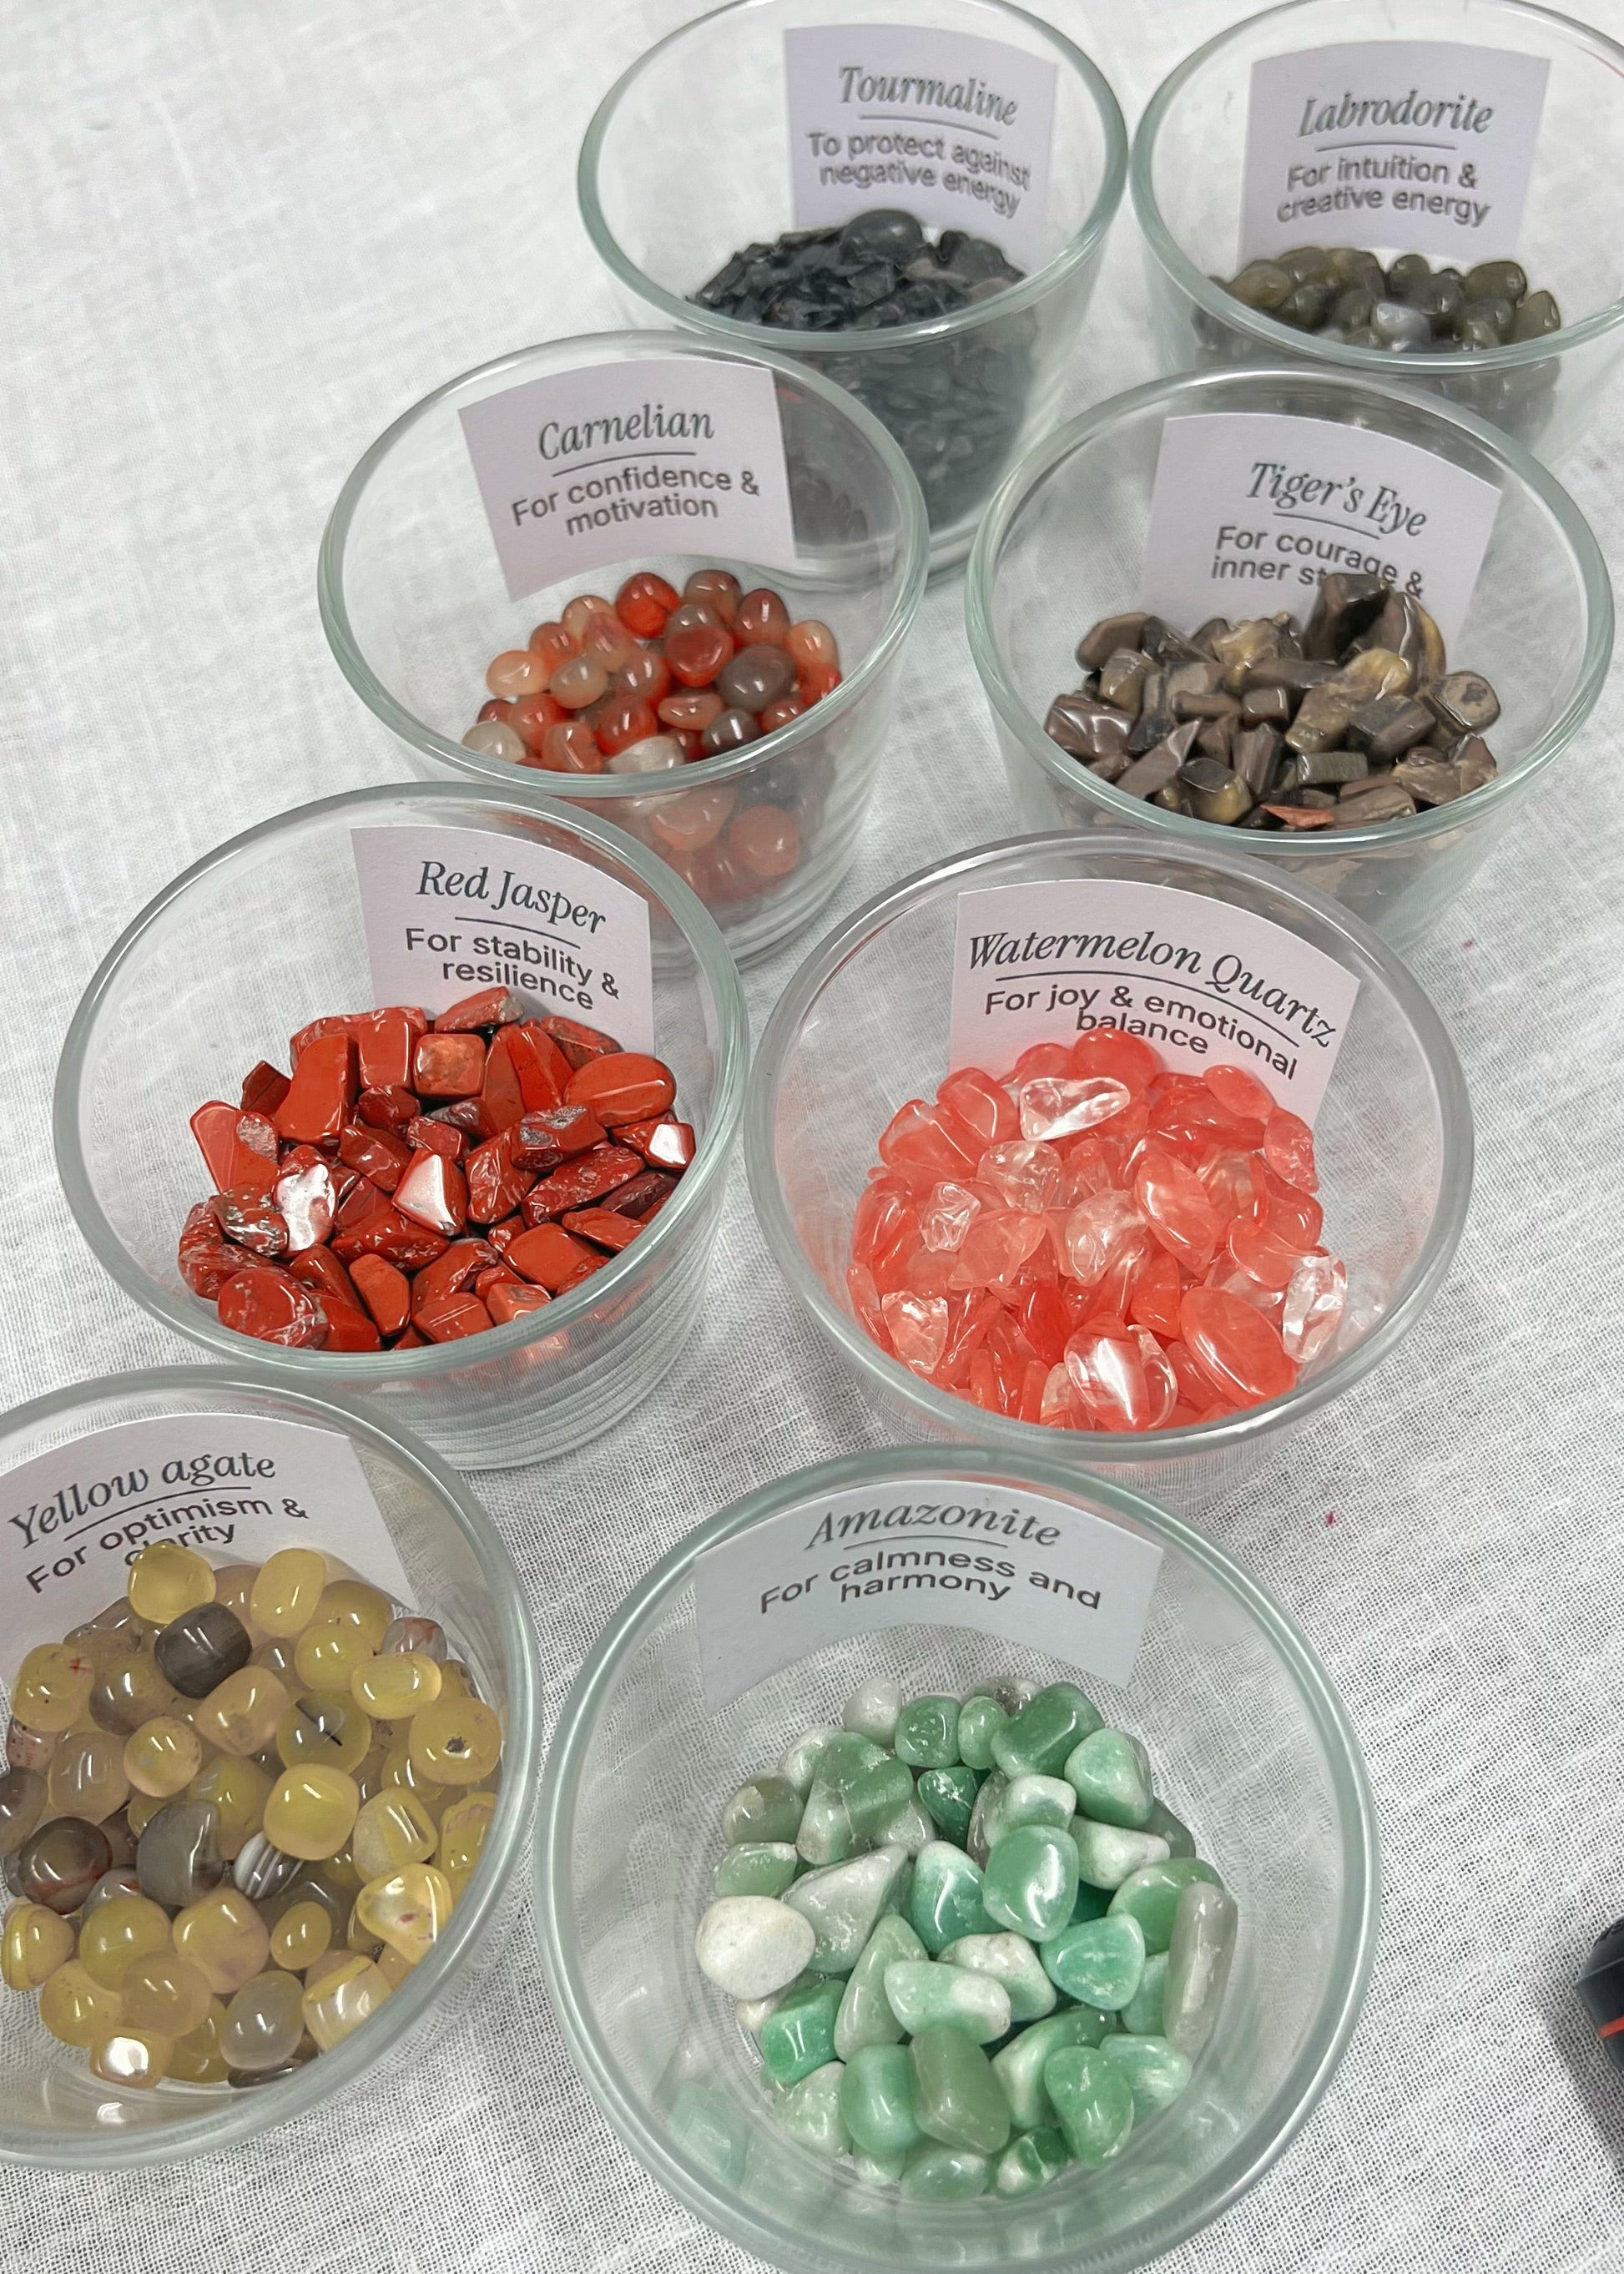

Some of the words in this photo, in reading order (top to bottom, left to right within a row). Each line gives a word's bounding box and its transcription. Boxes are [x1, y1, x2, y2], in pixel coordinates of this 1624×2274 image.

[839, 65, 1018, 125] Tourmaline
[1296, 88, 1494, 138] Labrodorite
[807, 132, 840, 157] To
[848, 133, 945, 161] protect
[951, 143, 1031, 191] against
[820, 160, 936, 189] negative
[943, 171, 1021, 219] energy
[1287, 165, 1331, 192] For
[1337, 155, 1449, 185] intuition
[1457, 164, 1477, 189] &
[1276, 187, 1384, 223] creative
[1392, 190, 1491, 228] energy
[539, 404, 714, 460] Carnelian
[512, 491, 558, 527] For
[567, 466, 732, 505] confidence
[741, 471, 759, 496] &
[566, 493, 719, 536] motivation
[1246, 462, 1364, 512] Tiger’s
[1365, 486, 1428, 537] Eye
[1211, 556, 1290, 581] inner
[1215, 526, 1268, 550] For
[1405, 571, 1423, 599] &
[416, 861, 490, 900] Red
[491, 870, 606, 934] Jasper
[406, 928, 461, 951] For
[473, 935, 593, 986] stability
[602, 972, 619, 1000] &
[443, 961, 593, 1010] resilience
[969, 931, 1201, 974] Watermelon
[1204, 955, 1336, 1048] Quartz
[985, 990, 1040, 1015] For
[1046, 984, 1100, 1011] joy
[1110, 986, 1132, 1008] &
[1144, 995, 1297, 1080] emotional
[1077, 1009, 1208, 1053] balance
[8, 1468, 149, 1549] Yellow
[162, 1452, 275, 1485] agate
[804, 1503, 1061, 1550] Amazonite
[25, 1547, 87, 1594] For
[99, 1498, 273, 1550] optimism
[282, 1498, 310, 1519] &
[124, 1524, 235, 1566] crity
[760, 1575, 819, 1614] For
[830, 1550, 1016, 1584] calmness
[1028, 1570, 1101, 1609] and
[840, 1572, 1012, 1602] harmony
